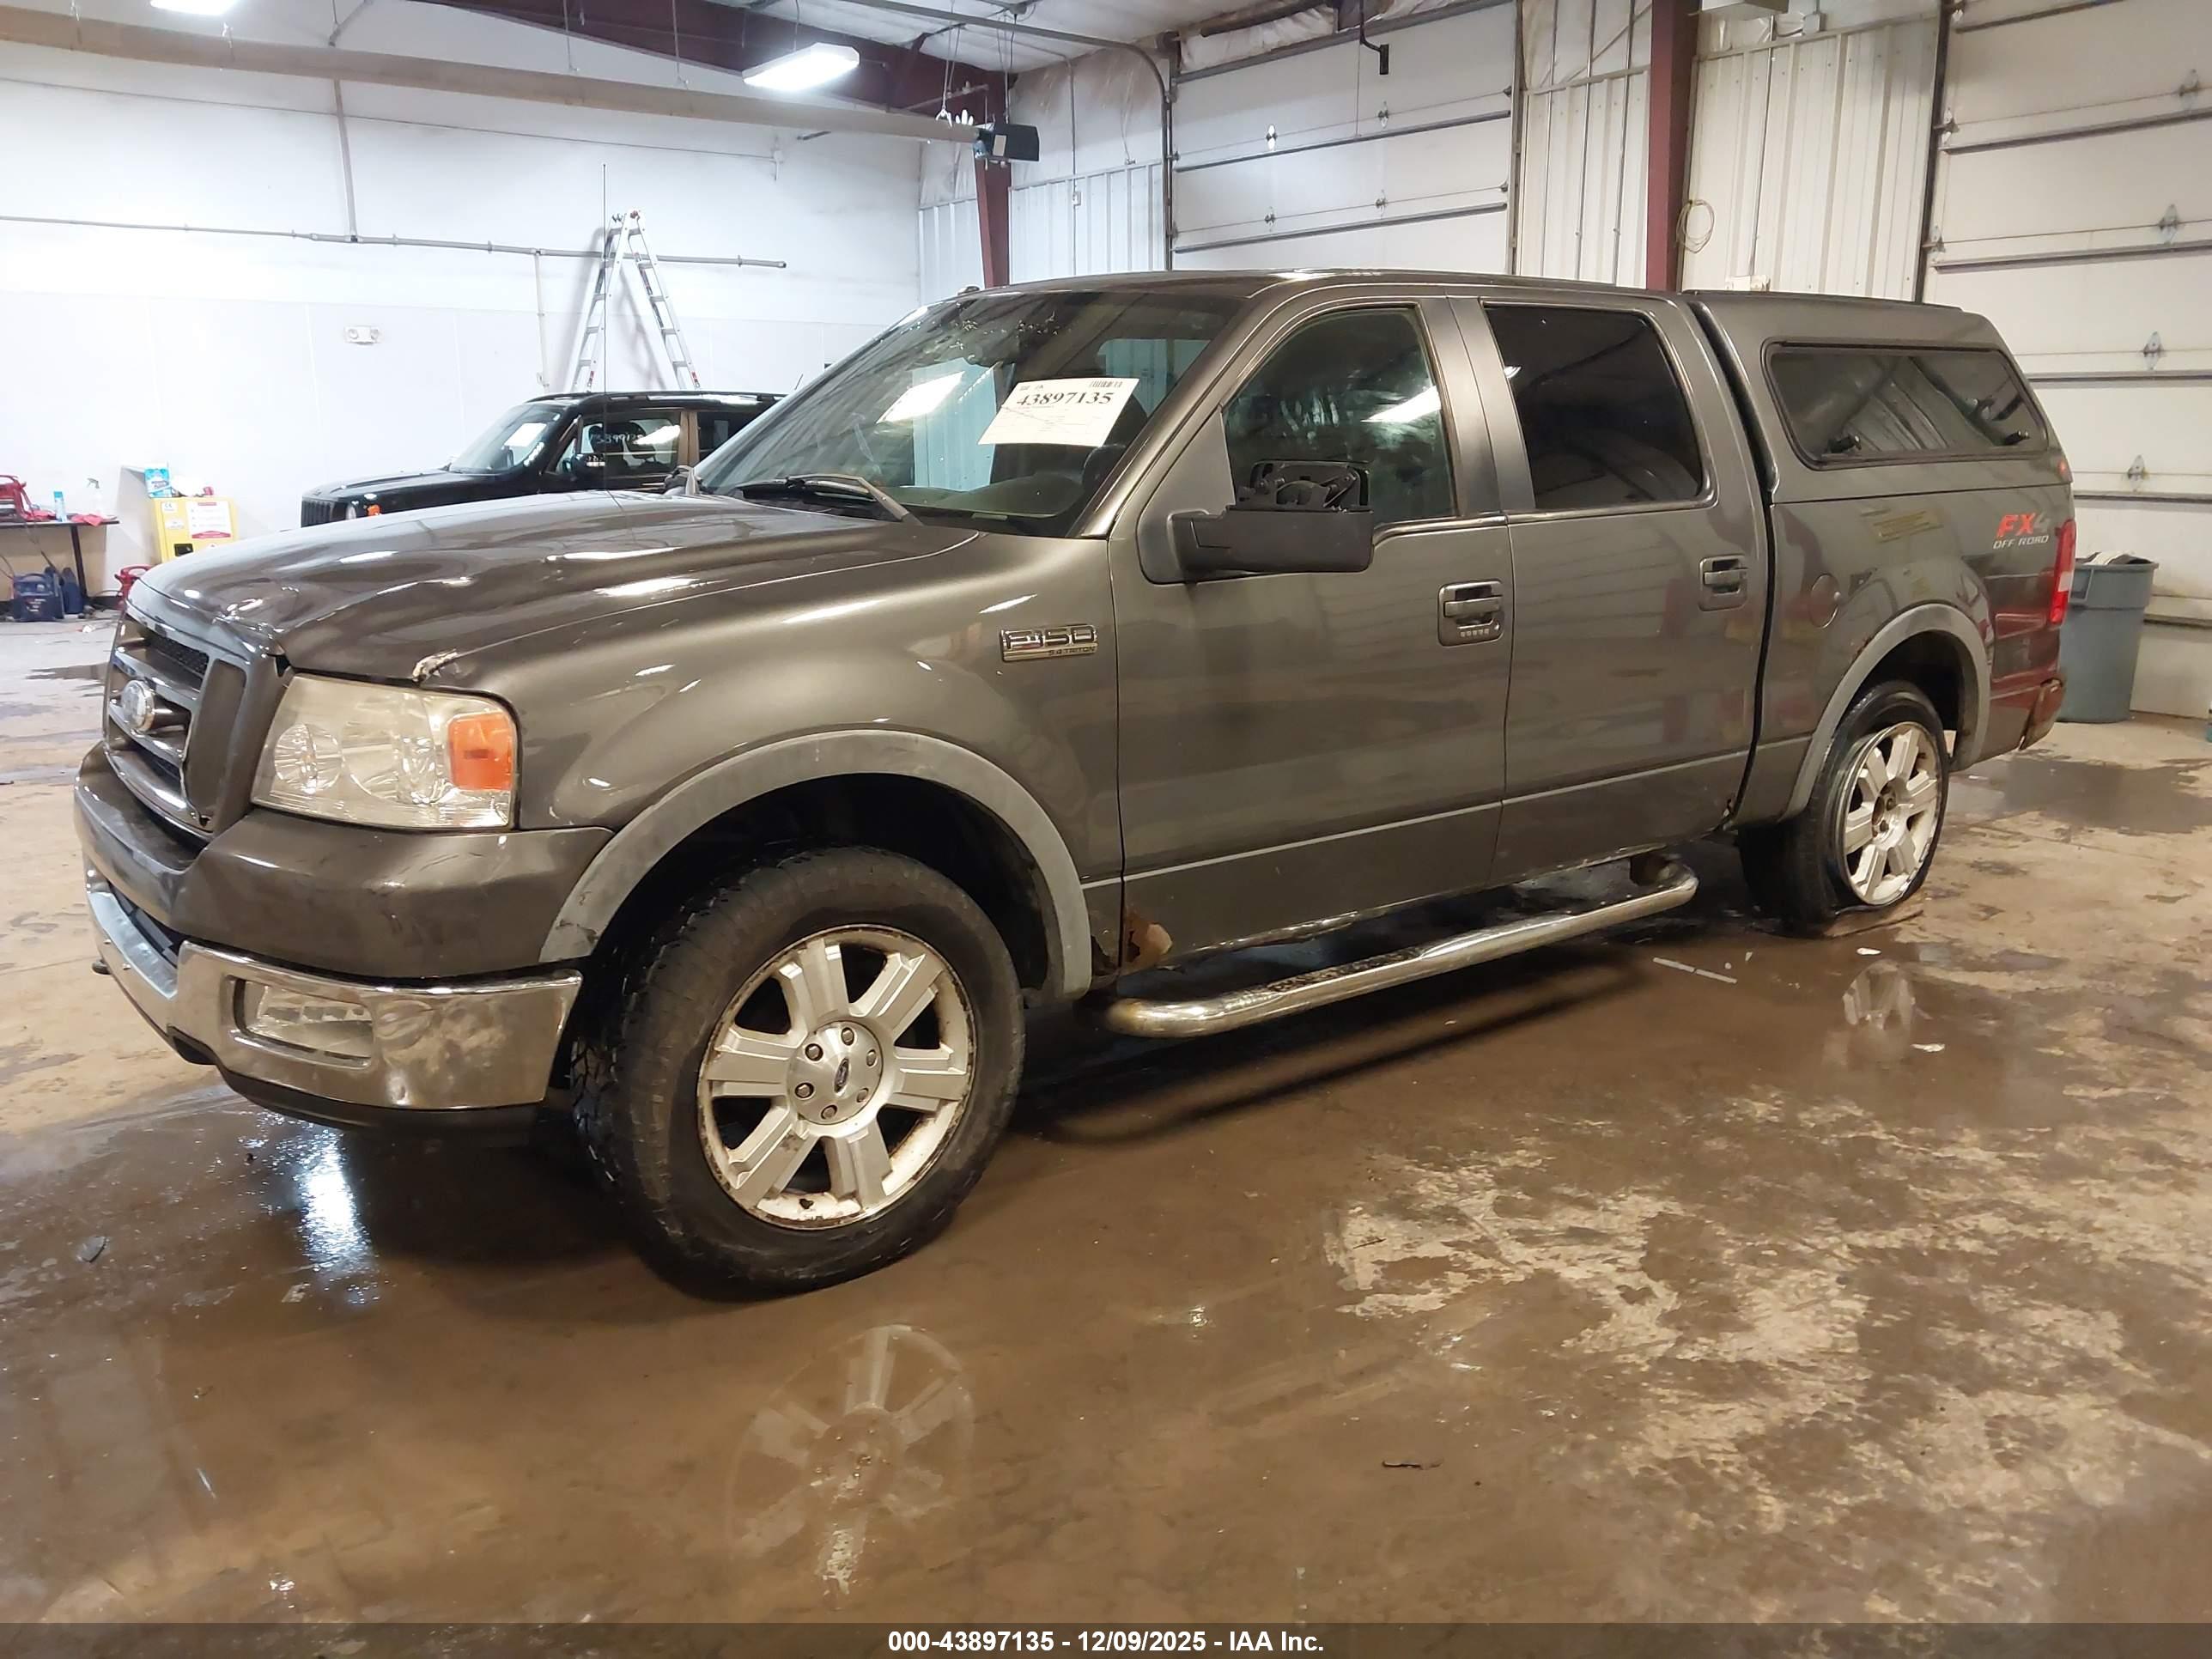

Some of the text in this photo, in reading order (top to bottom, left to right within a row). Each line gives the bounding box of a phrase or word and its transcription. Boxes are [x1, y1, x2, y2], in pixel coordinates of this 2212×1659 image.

[1017, 392, 1115, 405] 43897135
[1996, 512, 2051, 537] FX4
[1993, 535, 2050, 550] OFF ROAD
